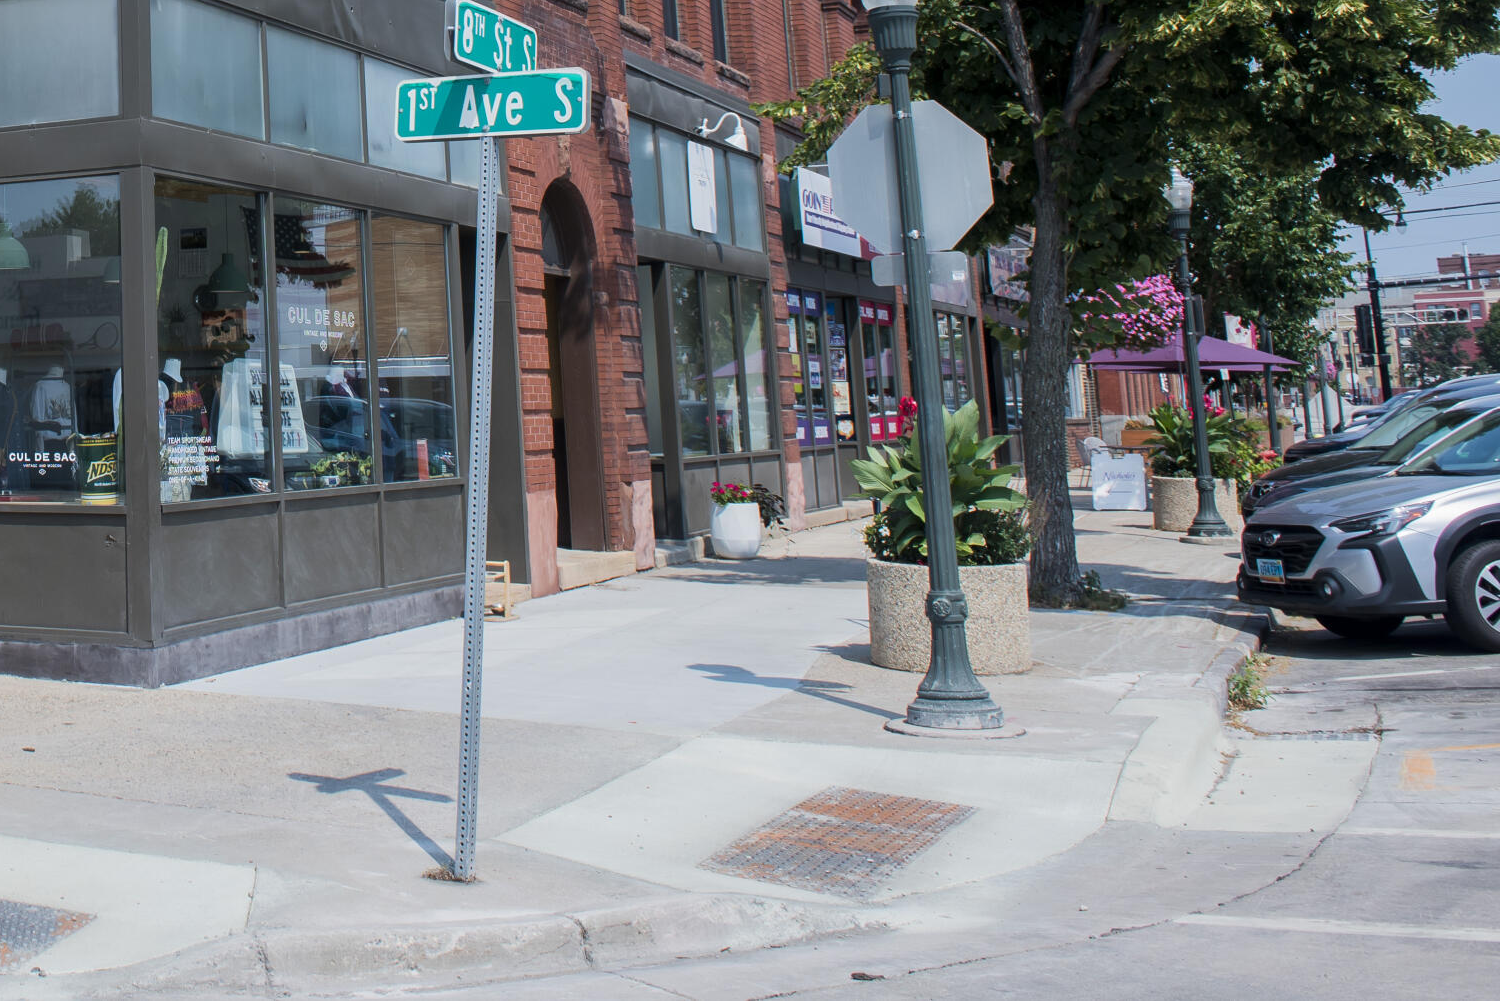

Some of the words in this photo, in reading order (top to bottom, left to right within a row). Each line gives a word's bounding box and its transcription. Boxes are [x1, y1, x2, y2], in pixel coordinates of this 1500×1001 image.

[462, 8, 486, 54] 8TH
[493, 21, 513, 69] St
[522, 34, 532, 72] S
[407, 87, 438, 132] 1ST
[459, 84, 524, 129] Ave
[553, 77, 574, 123] S
[287, 306, 311, 325] CUL
[314, 308, 331, 326] DE
[333, 310, 355, 328] SAC
[167, 437, 181, 445] TEAM
[8, 452, 31, 462] CUL
[34, 452, 50, 462] DE
[53, 452, 77, 462] SAC
